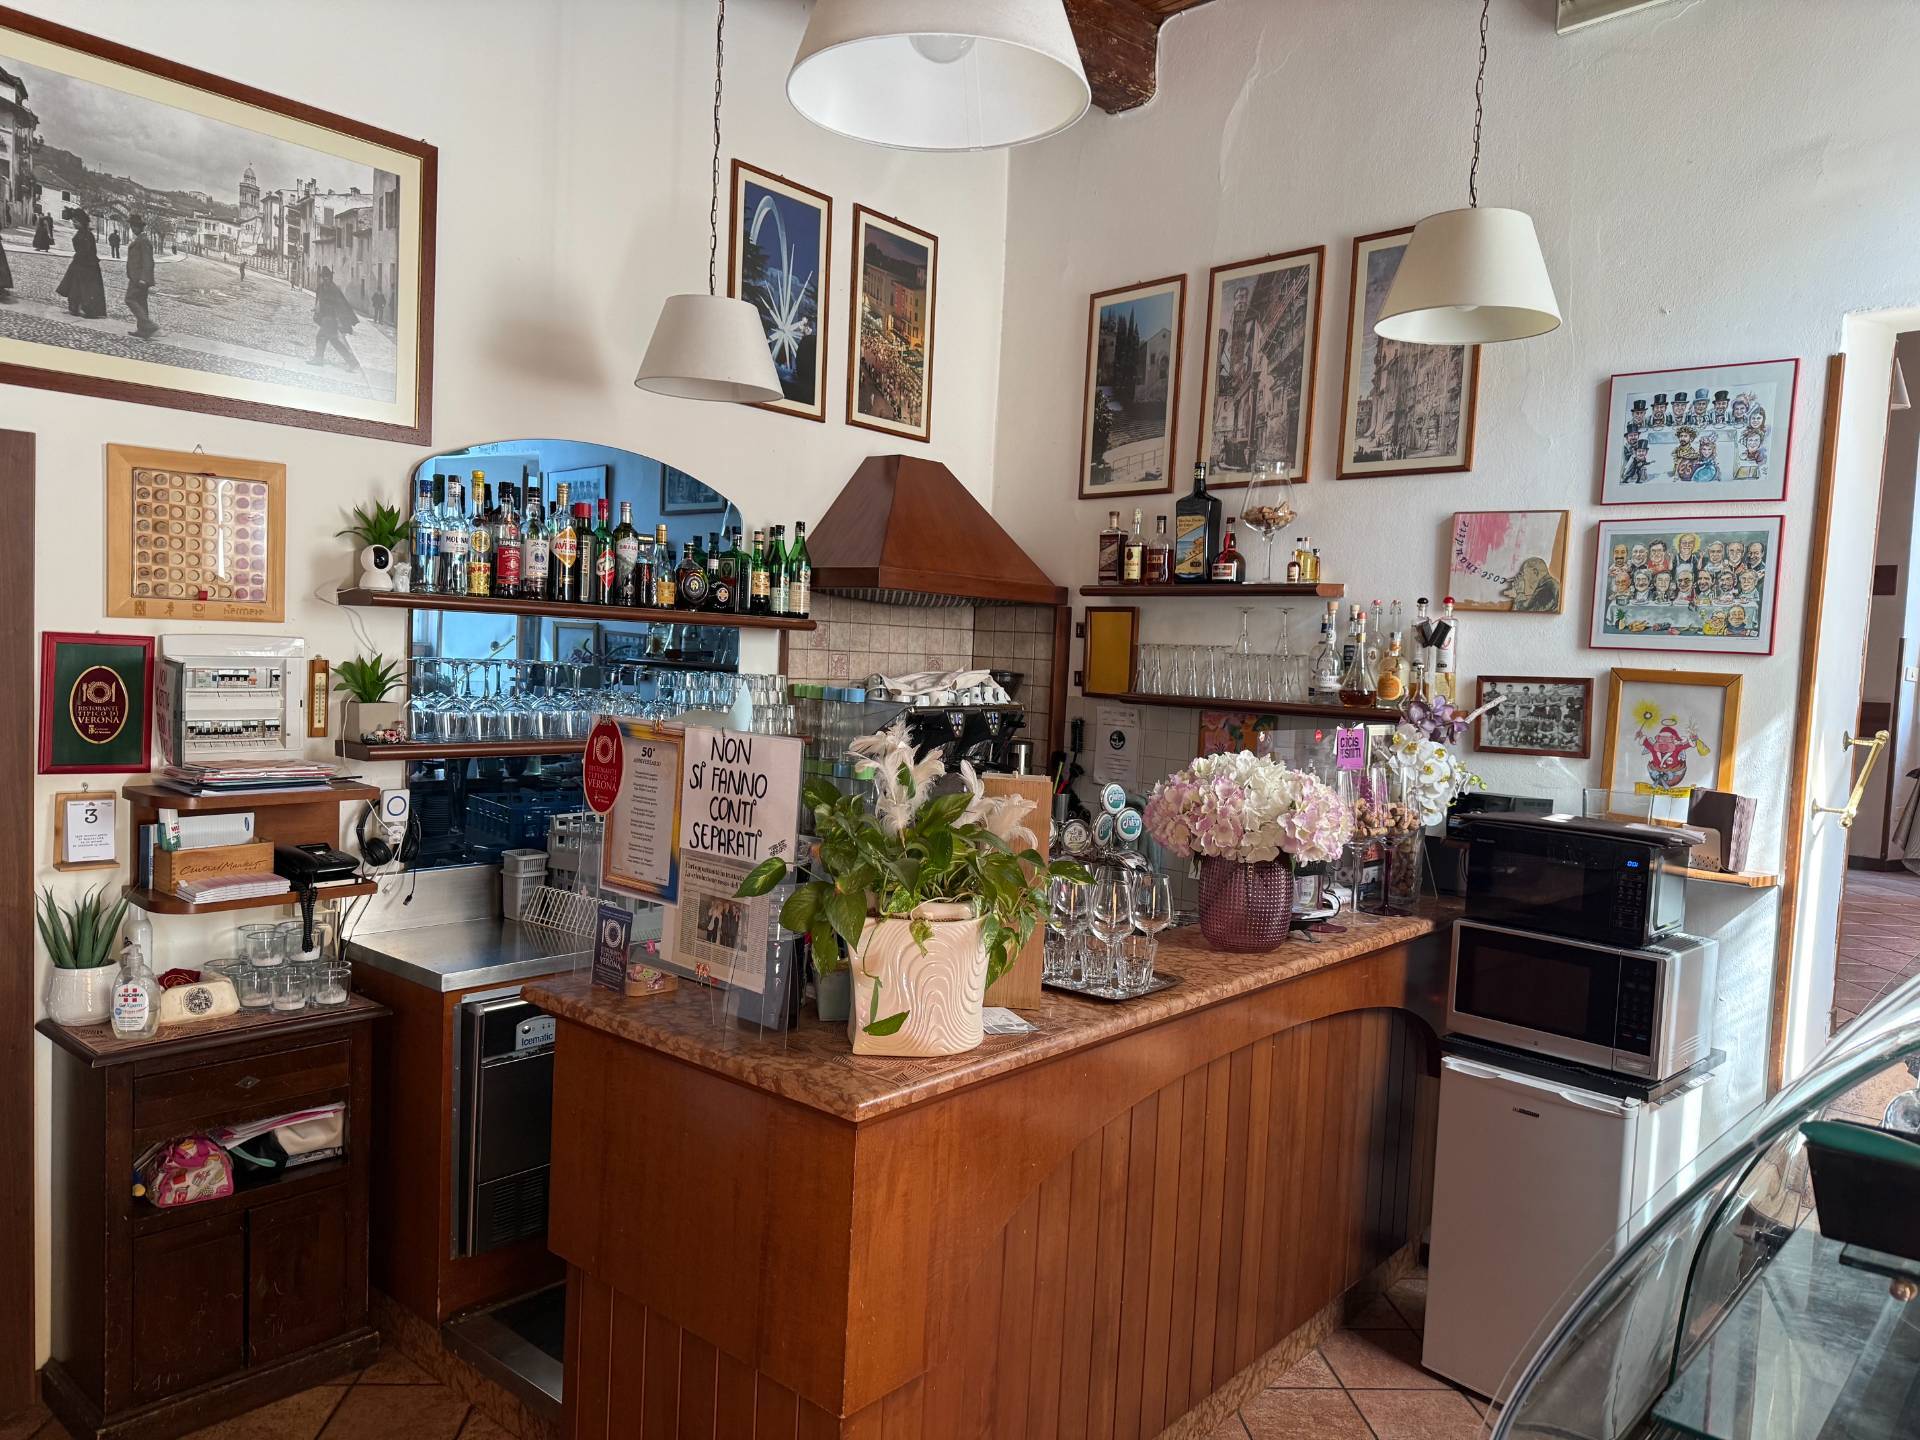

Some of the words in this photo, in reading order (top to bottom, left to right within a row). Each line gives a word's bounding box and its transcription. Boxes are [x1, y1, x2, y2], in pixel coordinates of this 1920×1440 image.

[1481, 570, 1506, 585] cose
[77, 716, 120, 724] VERONA
[711, 737, 752, 765] NON
[587, 777, 617, 792] VERONA
[711, 767, 768, 799] FANNO
[84, 808, 98, 824] 3
[709, 797, 757, 827] CONTI
[689, 822, 762, 860] SEPARATI
[521, 1033, 553, 1046] Icematic
